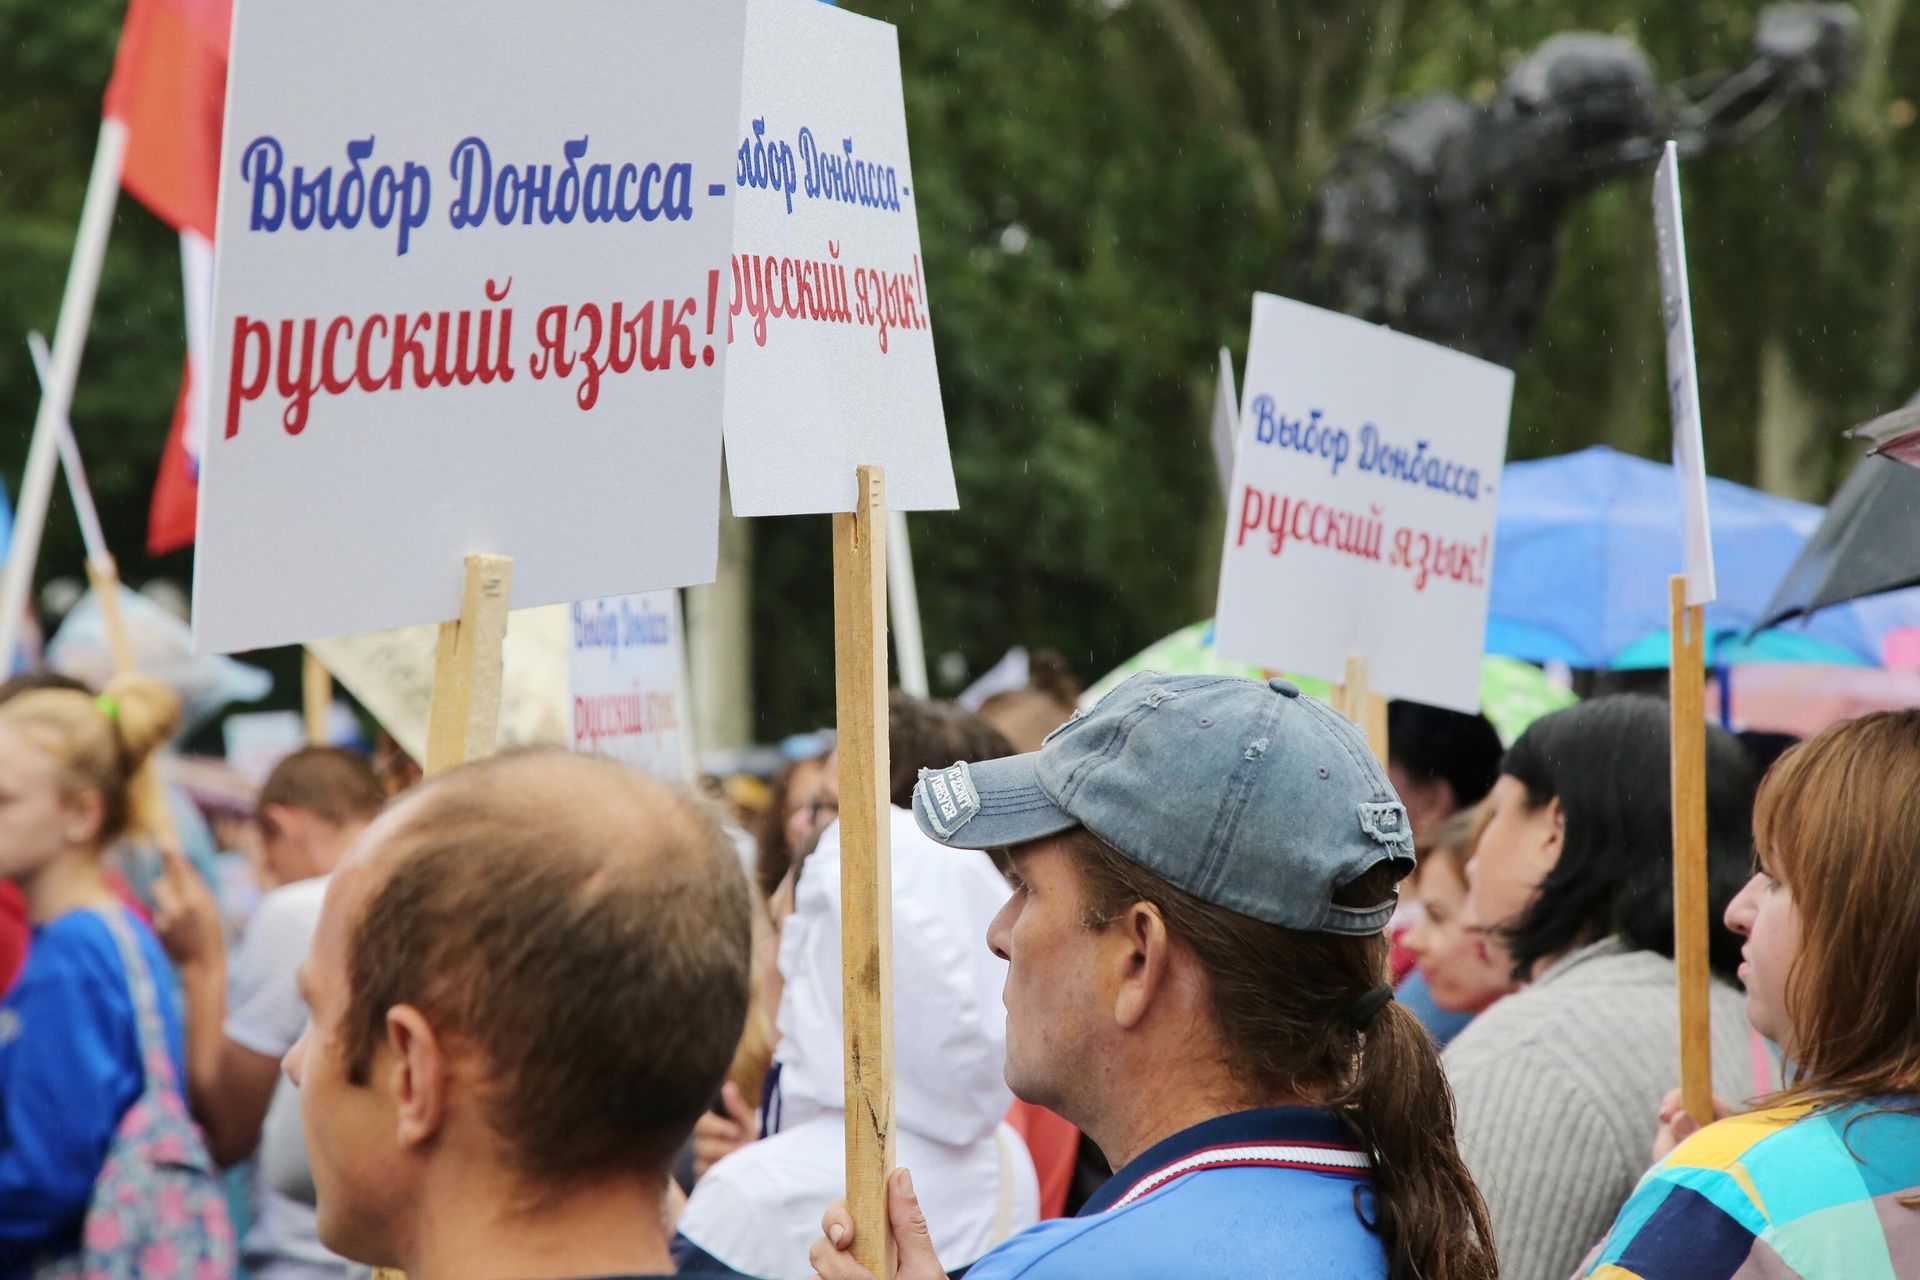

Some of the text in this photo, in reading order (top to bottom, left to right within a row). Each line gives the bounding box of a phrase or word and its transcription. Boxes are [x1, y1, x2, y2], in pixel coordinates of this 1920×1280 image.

[241, 134, 726, 257] Выбор Донбасса -
[736, 116, 796, 214] ыбор
[798, 126, 900, 213] Донбасса
[727, 239, 927, 354] русский язык!
[224, 270, 719, 440] русский язык!
[1253, 394, 1350, 476] Выбор
[1357, 422, 1480, 501] Донбасса
[1237, 484, 1488, 592] русский язык!
